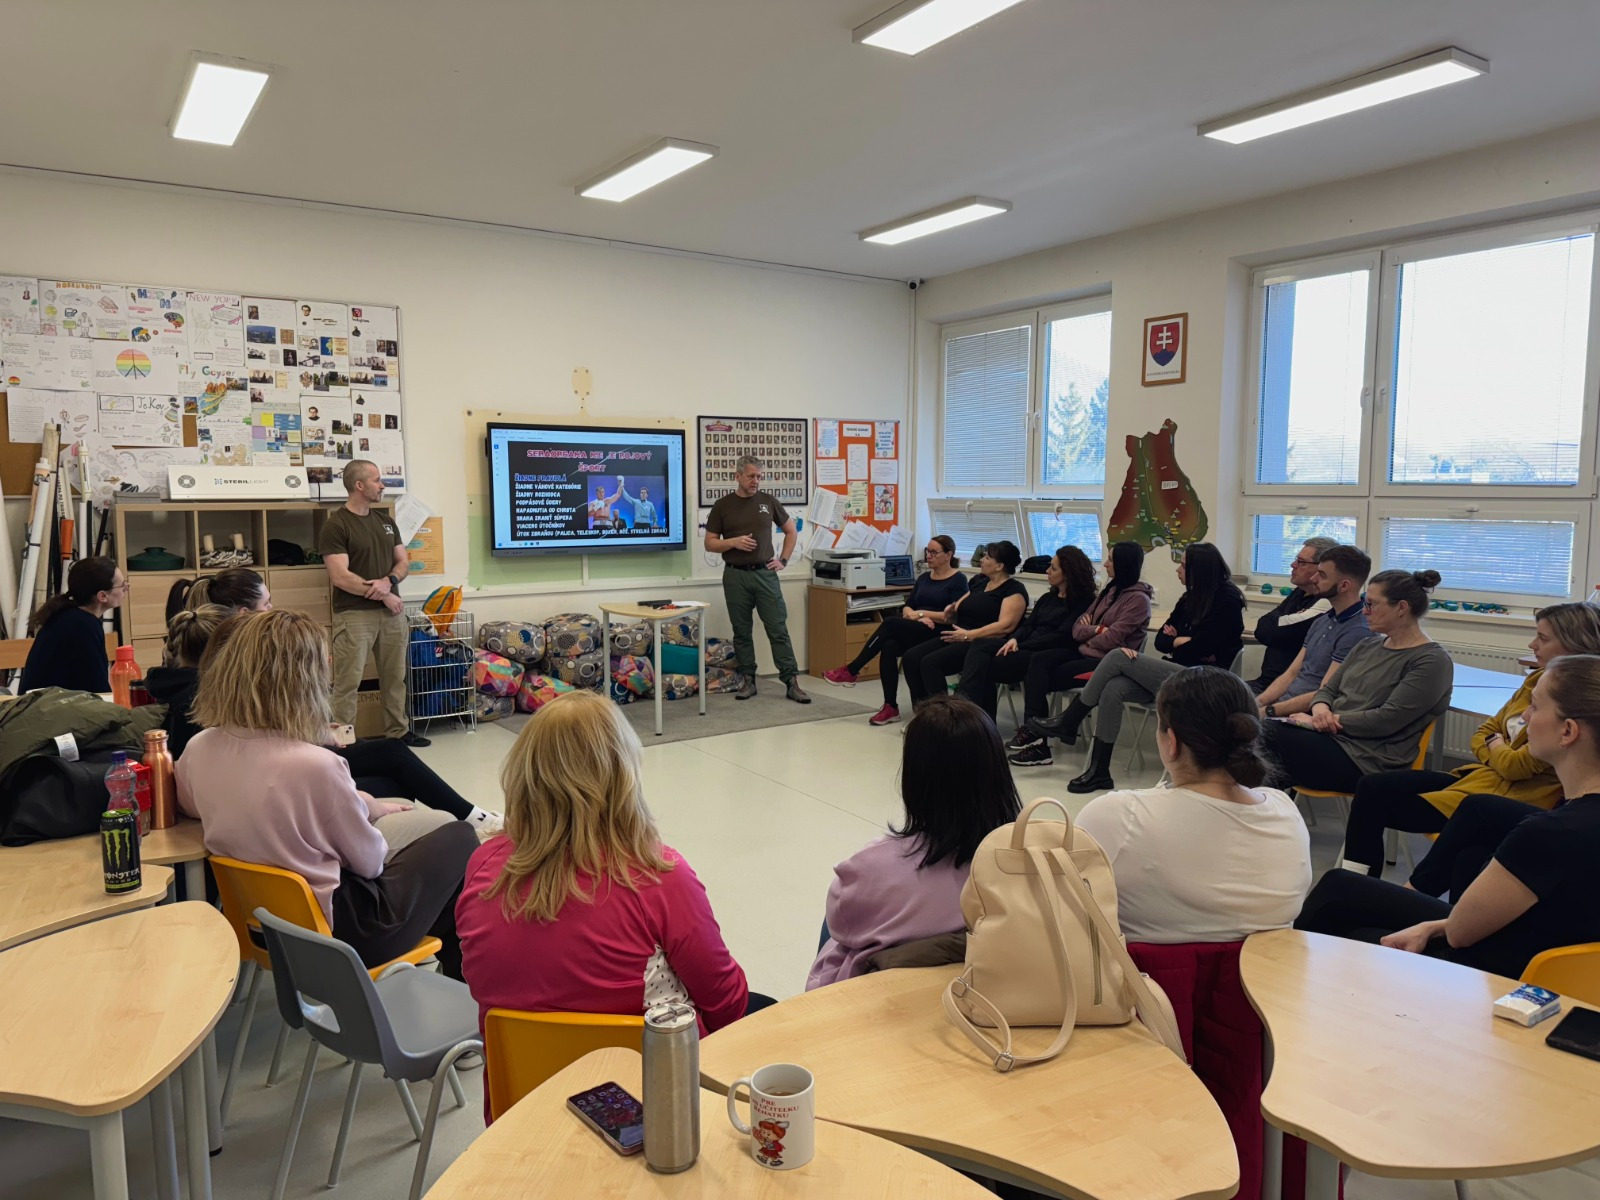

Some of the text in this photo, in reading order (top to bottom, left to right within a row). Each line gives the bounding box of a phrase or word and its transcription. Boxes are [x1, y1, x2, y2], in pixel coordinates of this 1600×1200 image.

[137, 288, 164, 300] HIP
[189, 294, 210, 302] NEW
[178, 364, 236, 380] Fly Geyser
[590, 451, 604, 459] NIE
[619, 450, 652, 460] BOJOVÝ
[578, 462, 606, 472] ŠPORT
